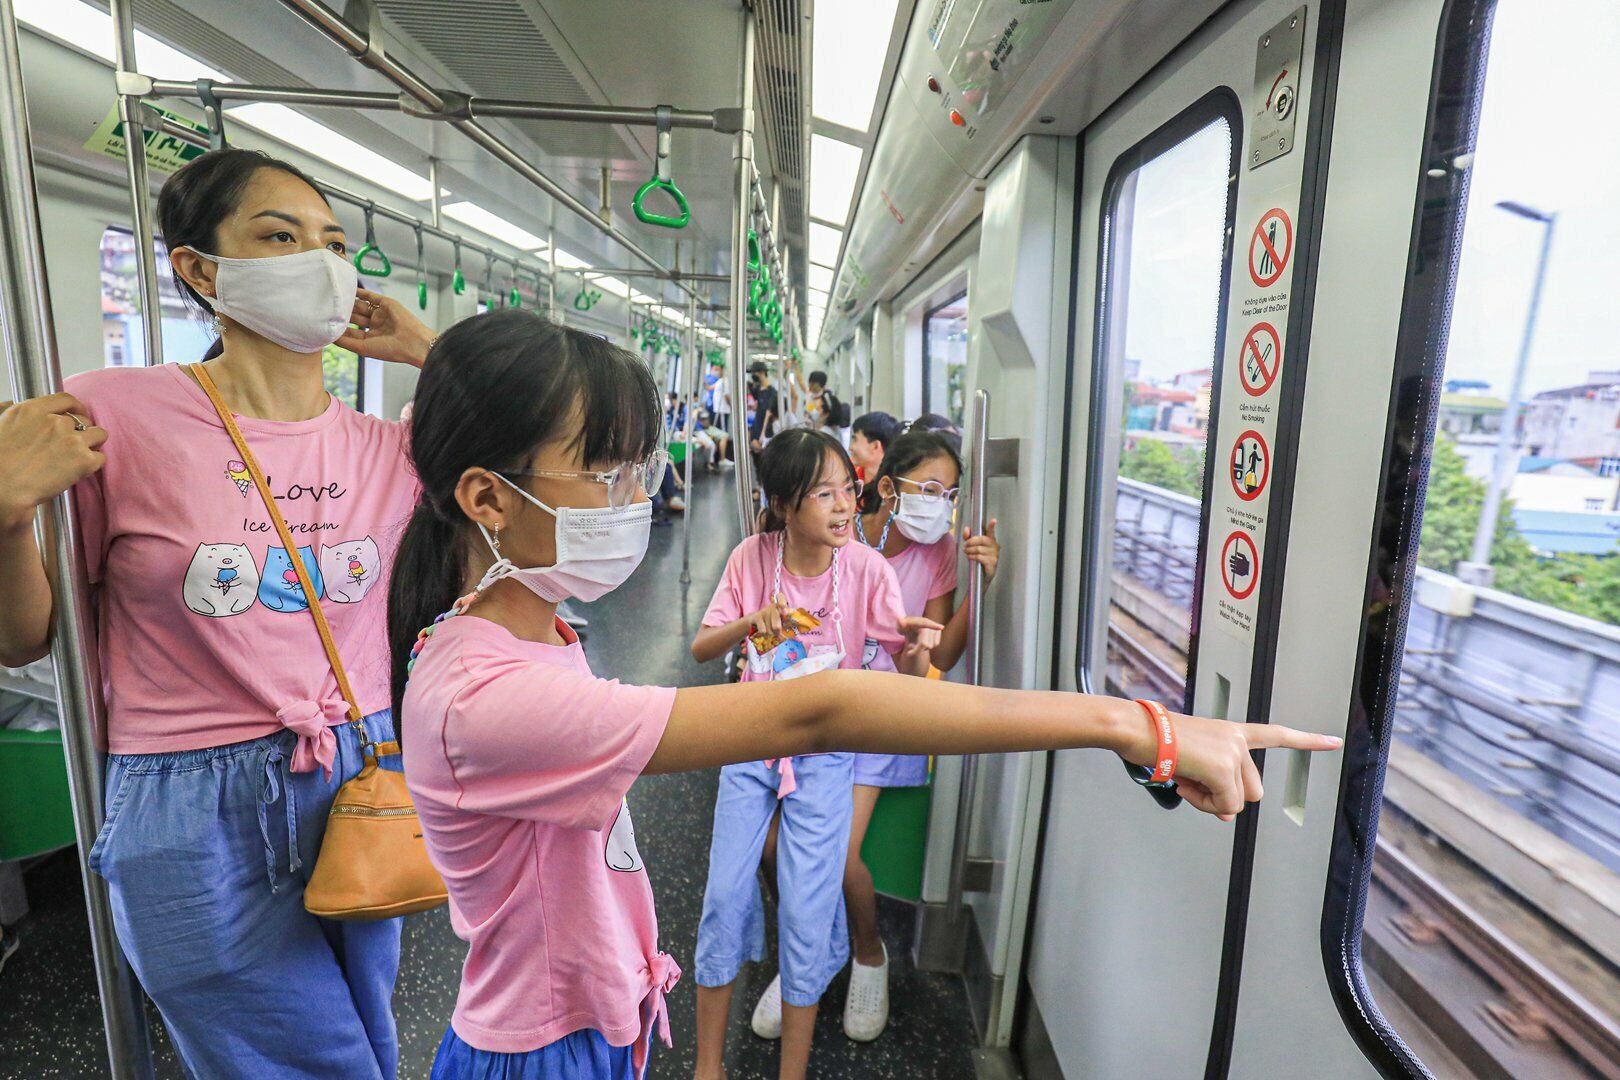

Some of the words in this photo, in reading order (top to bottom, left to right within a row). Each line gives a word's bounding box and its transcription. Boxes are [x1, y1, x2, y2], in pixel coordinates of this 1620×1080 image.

[1242, 309, 1252, 317] Keep
[1276, 303, 1288, 311] Door
[243, 518, 271, 532] Ice
